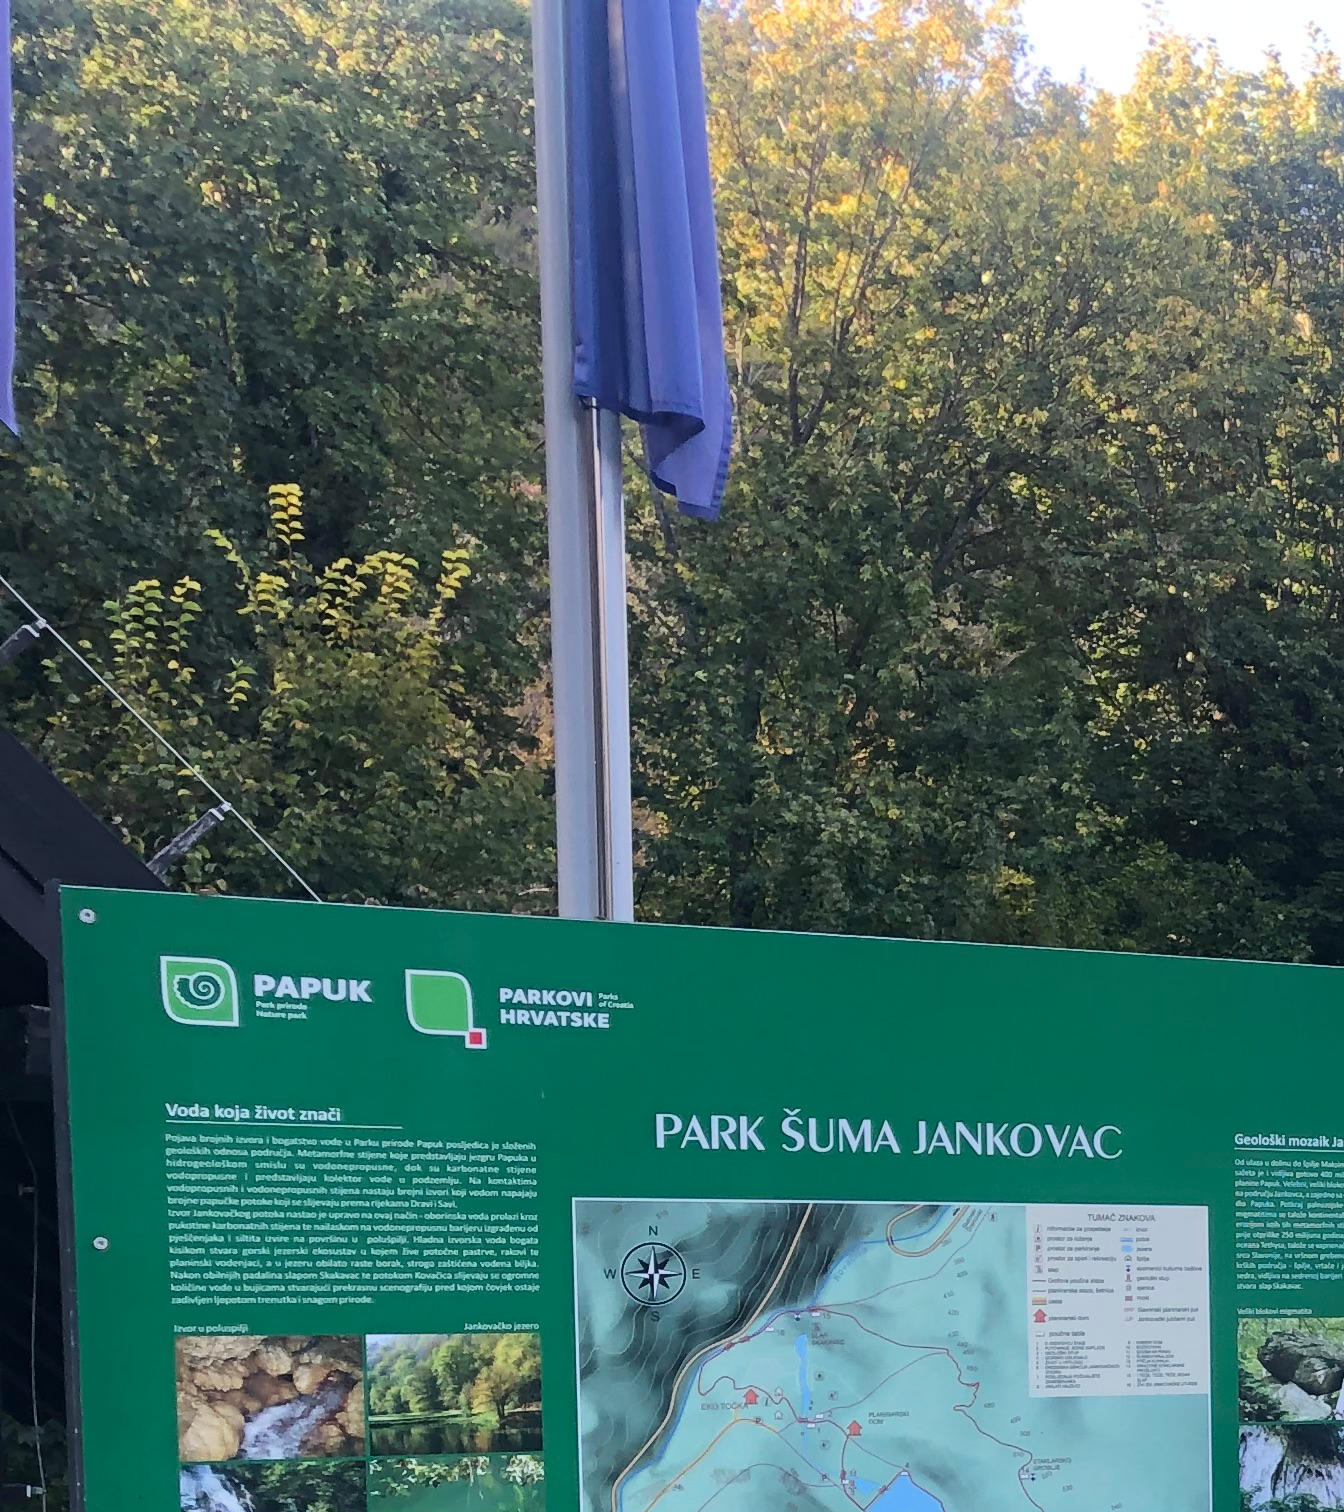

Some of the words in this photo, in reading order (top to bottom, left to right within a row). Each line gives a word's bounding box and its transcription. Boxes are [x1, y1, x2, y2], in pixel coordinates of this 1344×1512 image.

[254, 974, 372, 1002] PAPUK
[500, 988, 592, 1007] PARKOVI
[599, 993, 618, 1001] Parks
[256, 1001, 274, 1009] Park
[608, 1001, 634, 1009] Croatia
[256, 1010, 286, 1019] Nature
[288, 1011, 307, 1020] park
[500, 1009, 609, 1028] HRVATSKE
[165, 1103, 209, 1117] Voda
[214, 1104, 249, 1121] koja
[255, 1105, 295, 1120] život
[299, 1108, 341, 1121] znači
[655, 1113, 766, 1152] PARK
[782, 1108, 901, 1154] ŠUMA
[913, 1122, 1123, 1160] JANKOVAC
[1235, 1134, 1285, 1146] Geološki
[1289, 1136, 1329, 1147] mozaik
[404, 1164, 422, 1172] dok
[447, 1164, 499, 1173] karbonatne
[506, 1166, 536, 1174] stijene
[469, 1176, 481, 1184] Na
[1088, 1213, 1116, 1222] TUMAČ
[1118, 1214, 1156, 1222] ZNAKOVA
[649, 1226, 658, 1236] N
[604, 1269, 617, 1279] W
[692, 1269, 700, 1279] E
[651, 1311, 660, 1322] S
[464, 1322, 512, 1331] Jankovačko
[514, 1322, 540, 1331] jezero
